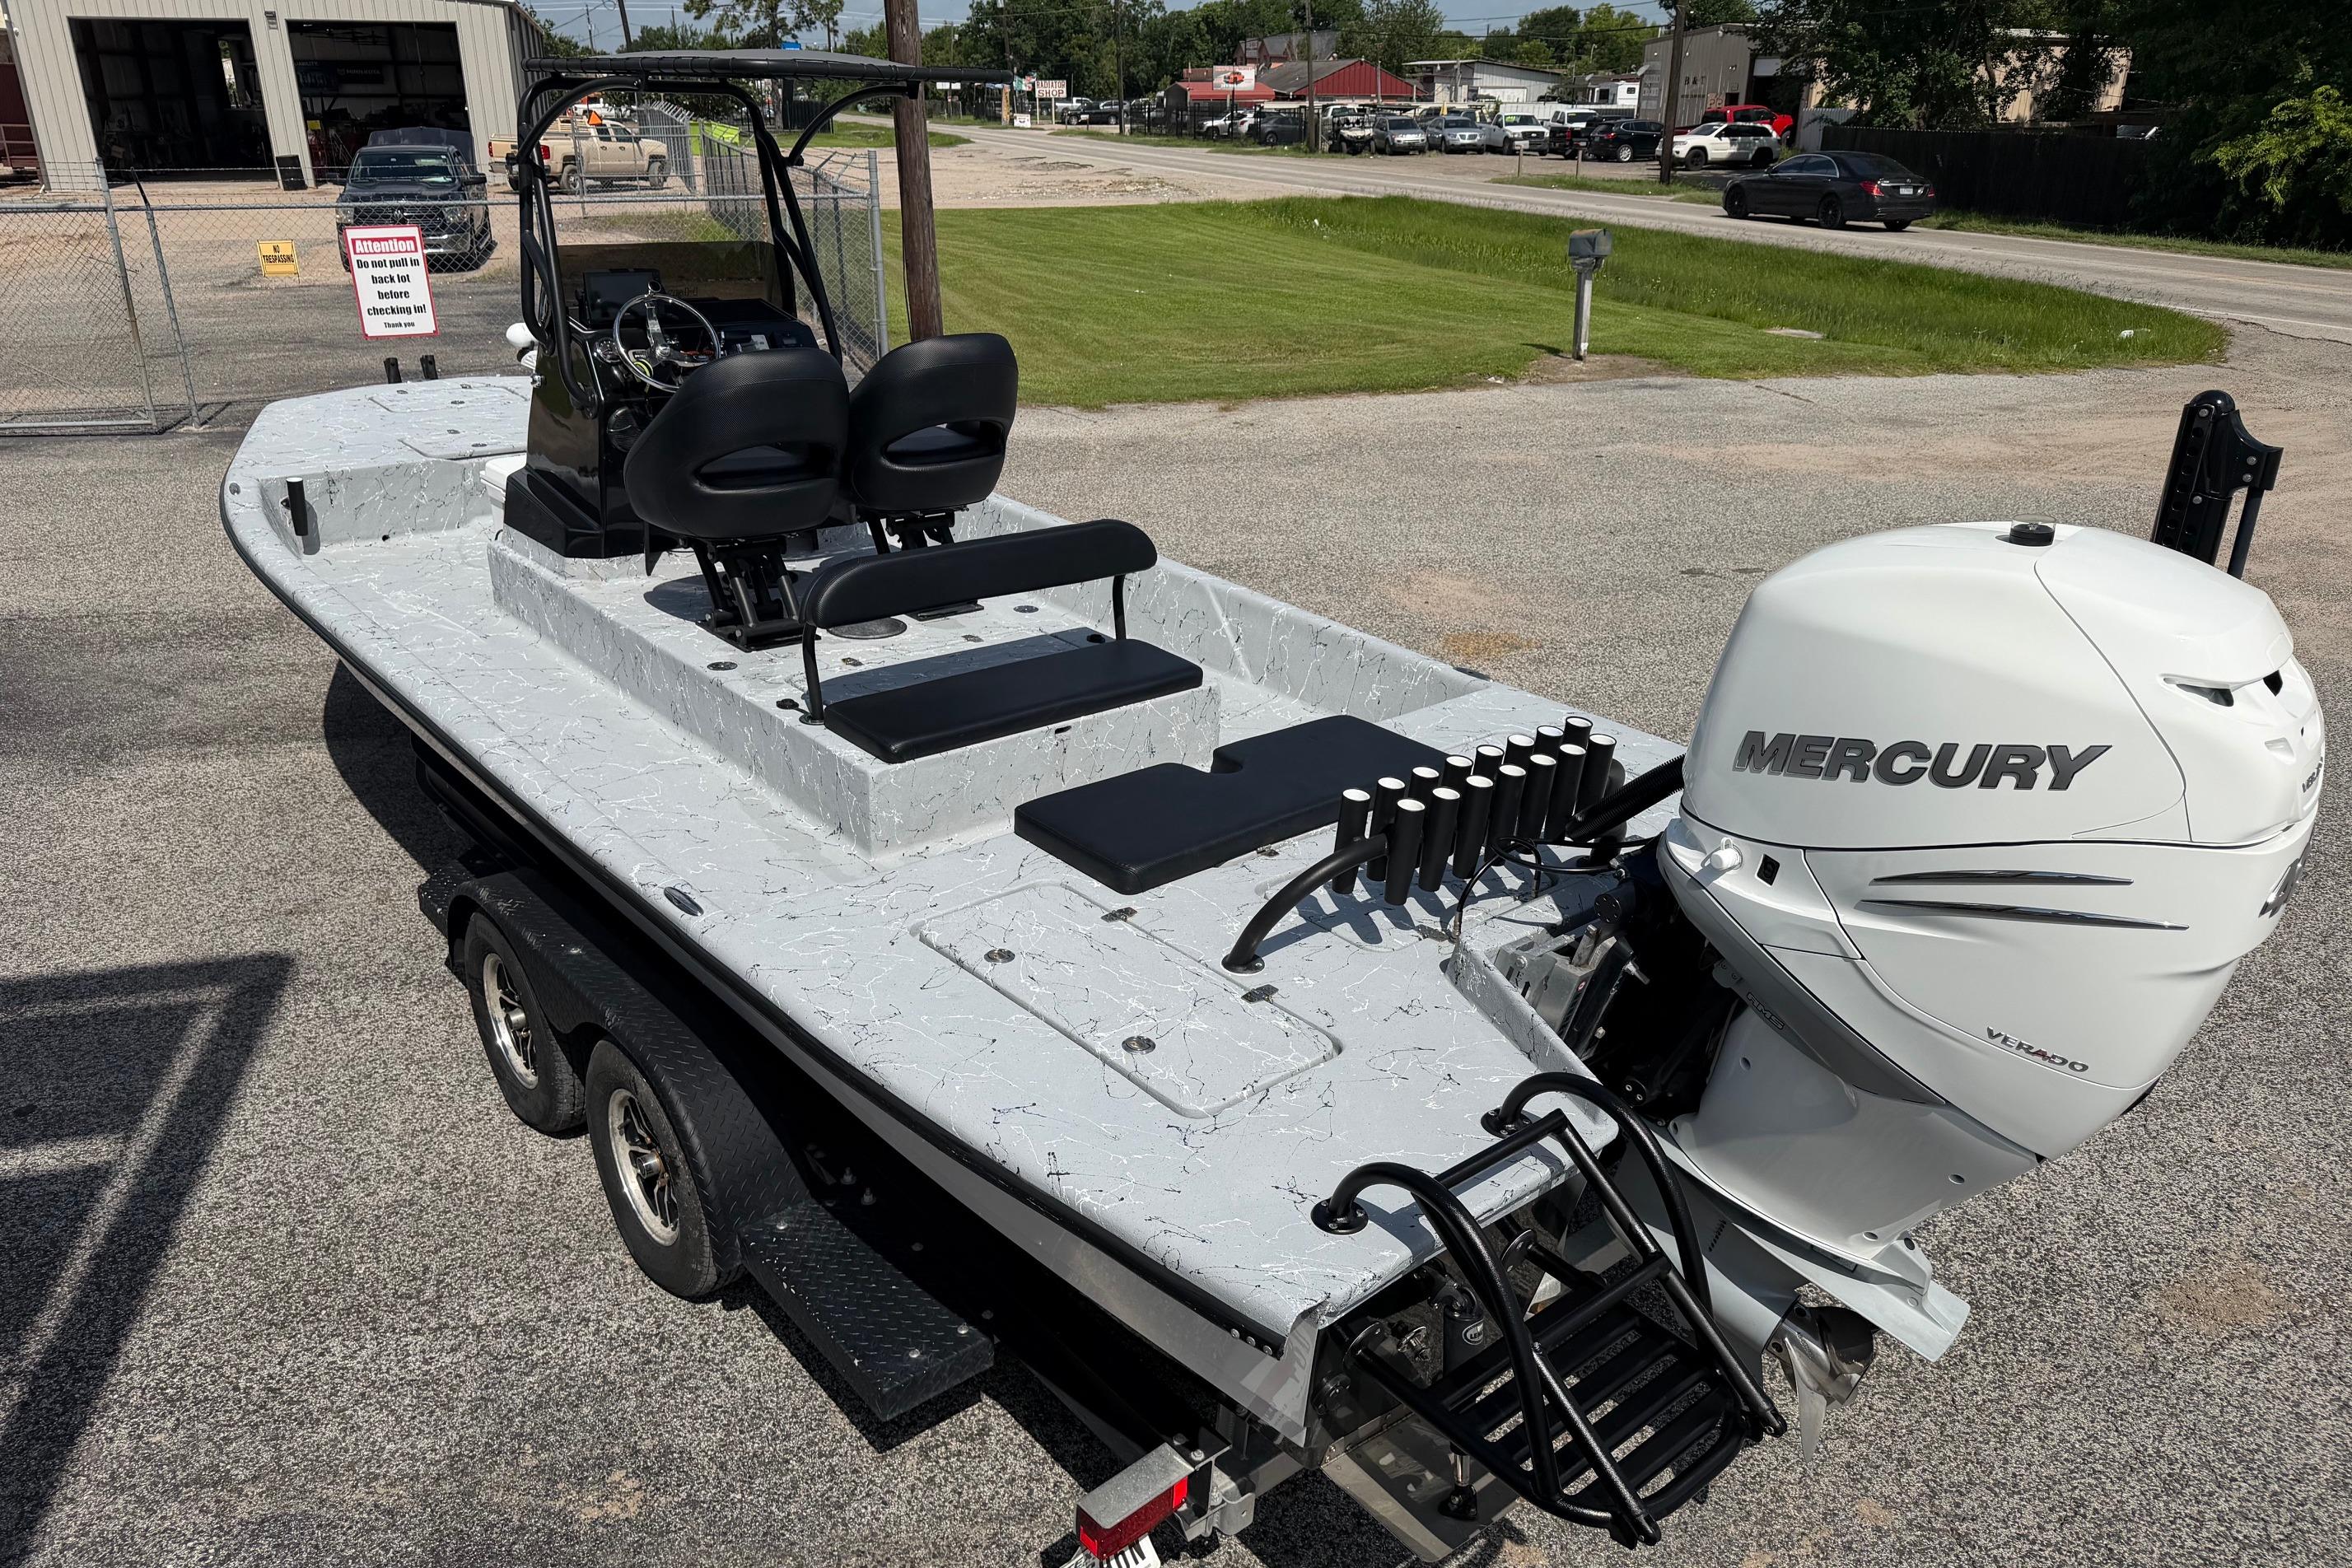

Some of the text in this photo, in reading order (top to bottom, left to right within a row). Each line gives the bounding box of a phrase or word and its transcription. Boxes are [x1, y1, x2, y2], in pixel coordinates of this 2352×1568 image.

[1037, 81, 1066, 89] RADIATOR
[1038, 89, 1064, 97] SHOP
[273, 244, 281, 254] NO
[355, 238, 416, 254] Attention
[262, 254, 295, 264] TRESPASSING
[356, 256, 420, 269] Do not pull in
[371, 273, 411, 284] back lot
[377, 290, 410, 300] before
[366, 303, 427, 316] checking in!
[383, 320, 415, 329] Thank you
[1731, 730, 2113, 791] MERCURY
[1986, 1025, 2089, 1073] VERADO
